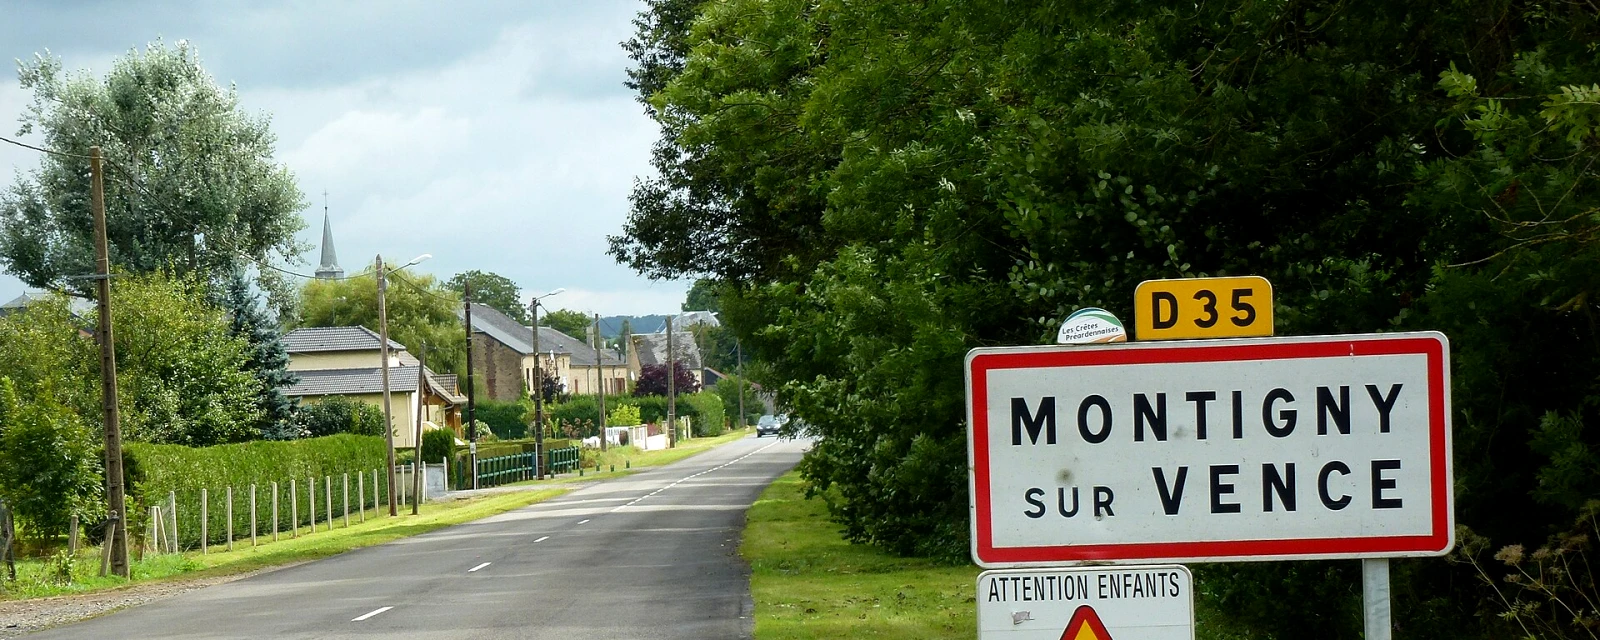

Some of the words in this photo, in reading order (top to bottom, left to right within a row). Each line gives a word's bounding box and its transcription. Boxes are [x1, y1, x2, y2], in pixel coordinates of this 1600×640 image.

[1065, 326, 1119, 341] Préardennaises
[1075, 323, 1099, 332] Crêtes
[1010, 383, 1404, 446] MONTIGNY
[1023, 486, 1115, 519] SUR
[1151, 459, 1403, 516] VENCE
[988, 574, 1088, 602] ATTENTION
[1098, 572, 1180, 599] ENFANTS
